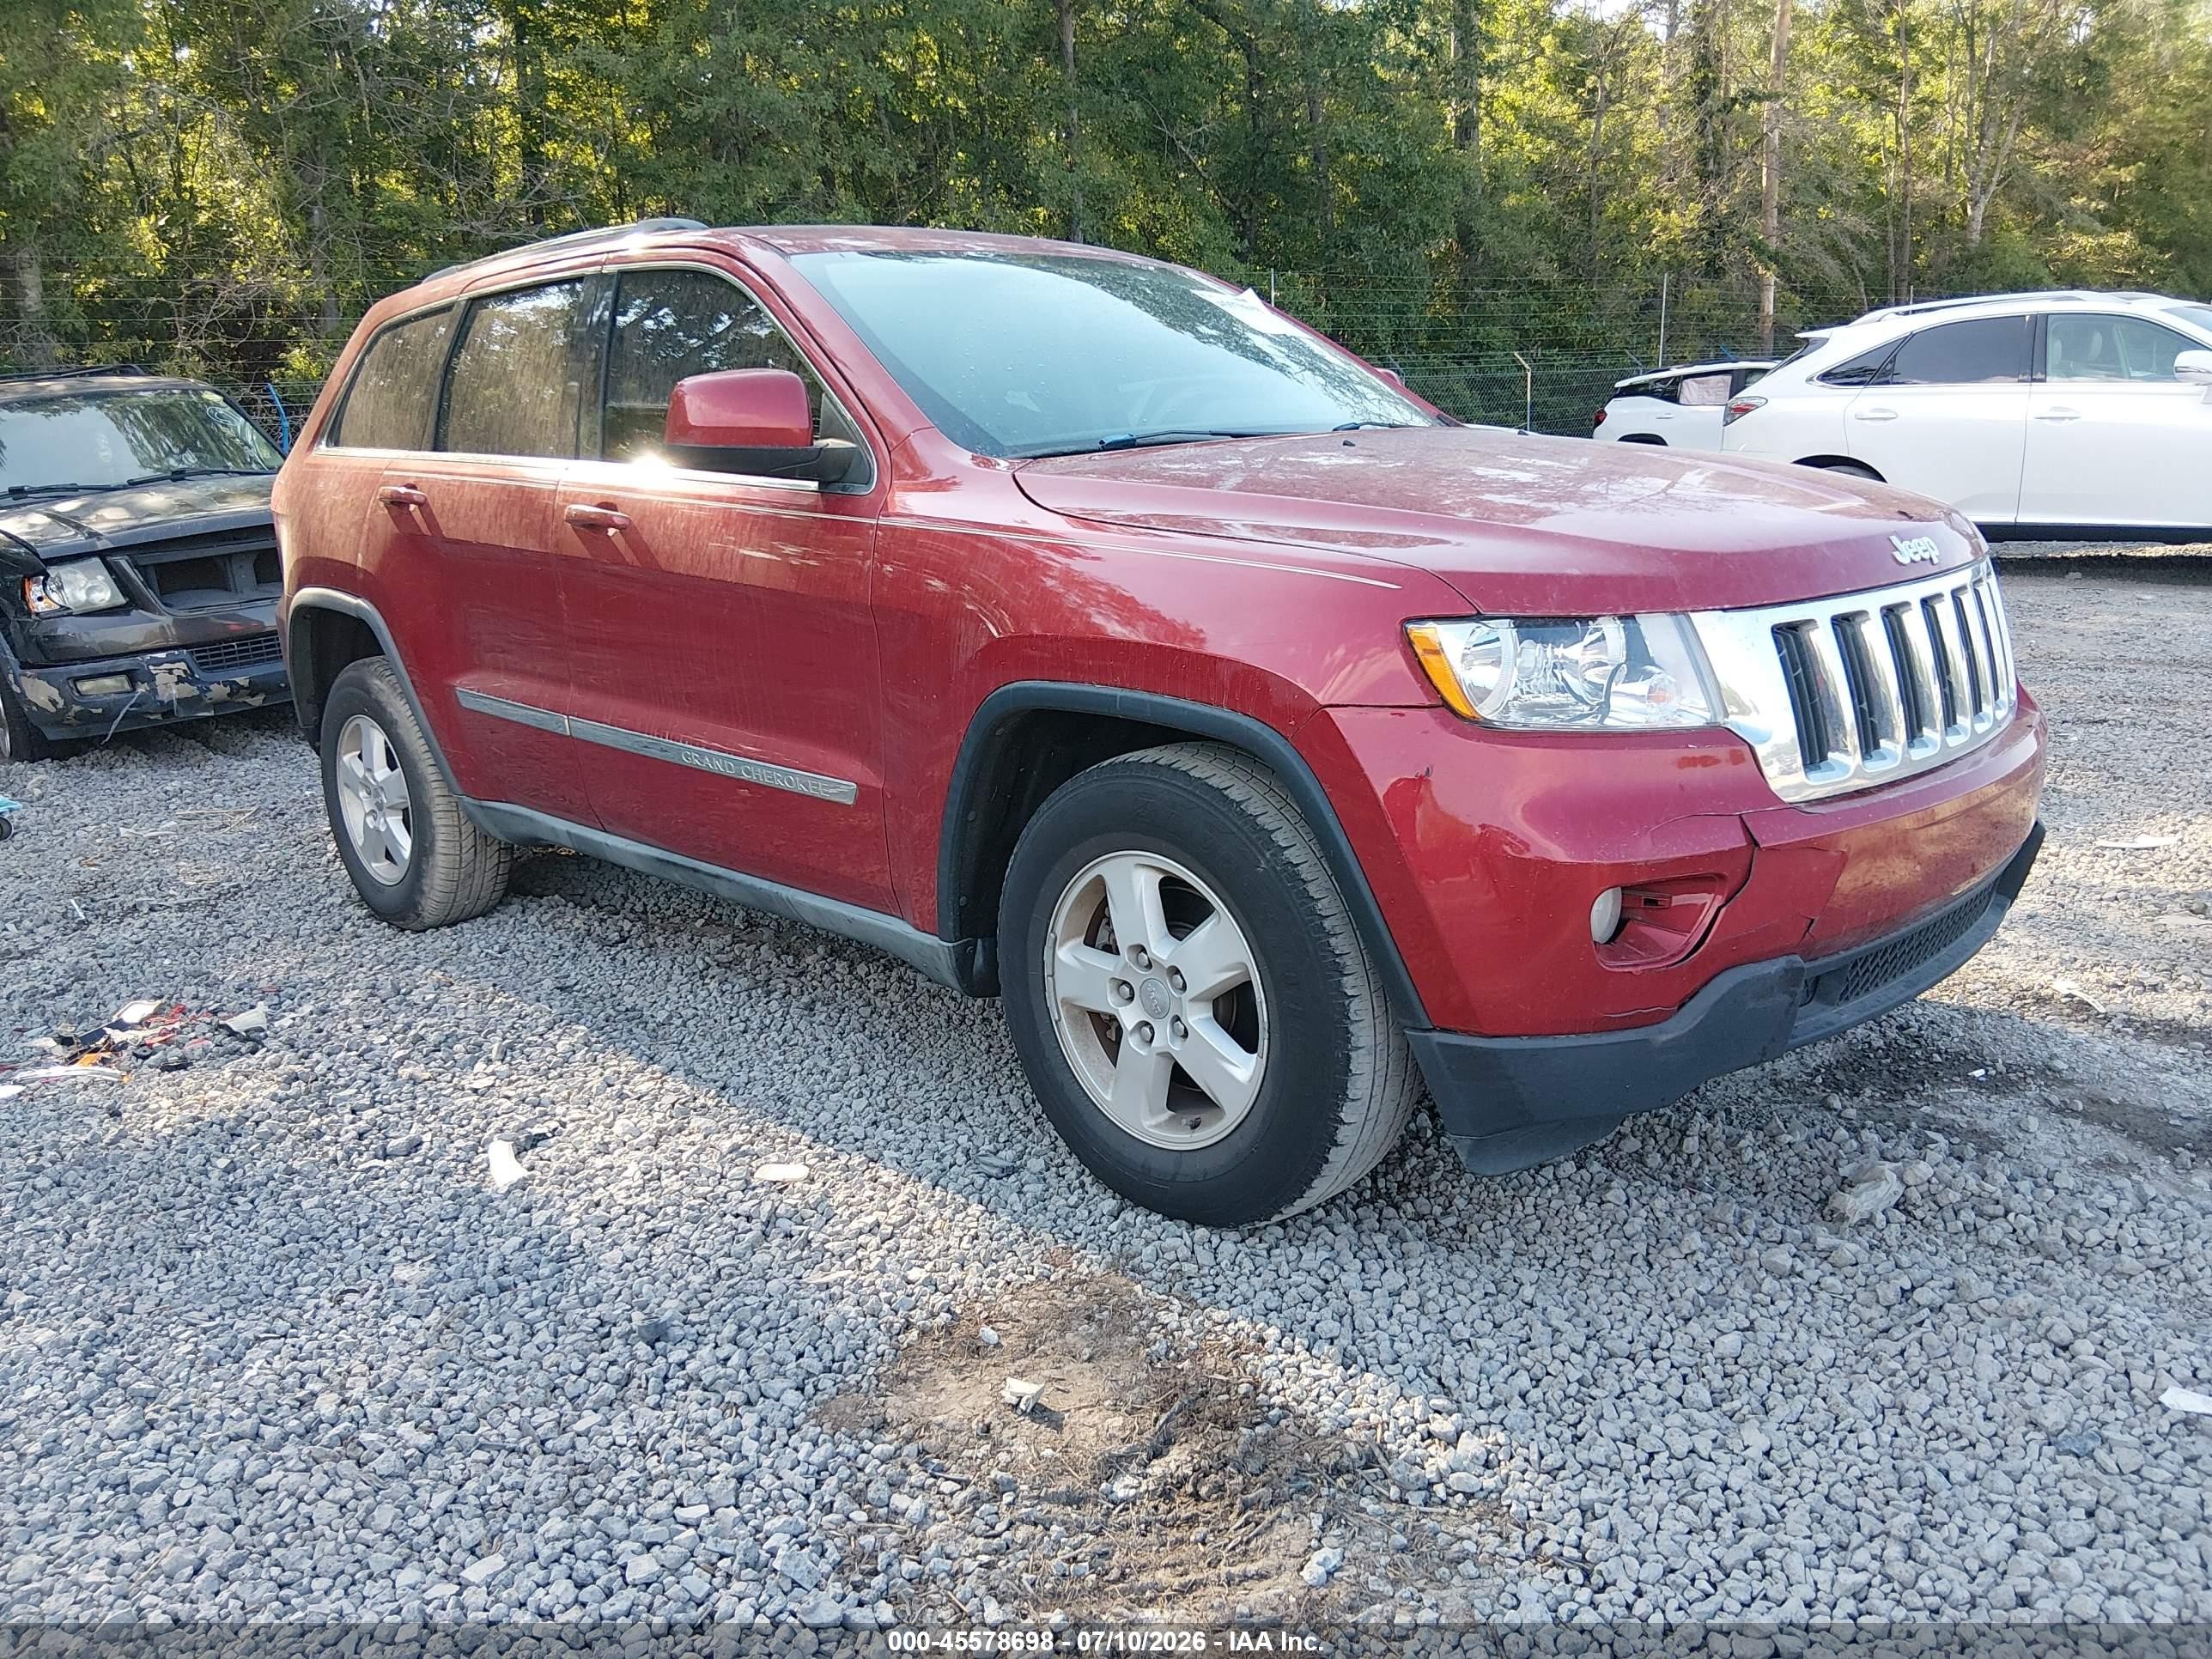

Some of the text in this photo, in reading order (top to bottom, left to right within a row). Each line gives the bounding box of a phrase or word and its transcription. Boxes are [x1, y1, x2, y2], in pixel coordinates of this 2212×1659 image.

[1888, 535, 1940, 565] Jeep
[681, 750, 830, 797] GRAND CHEROKEE
